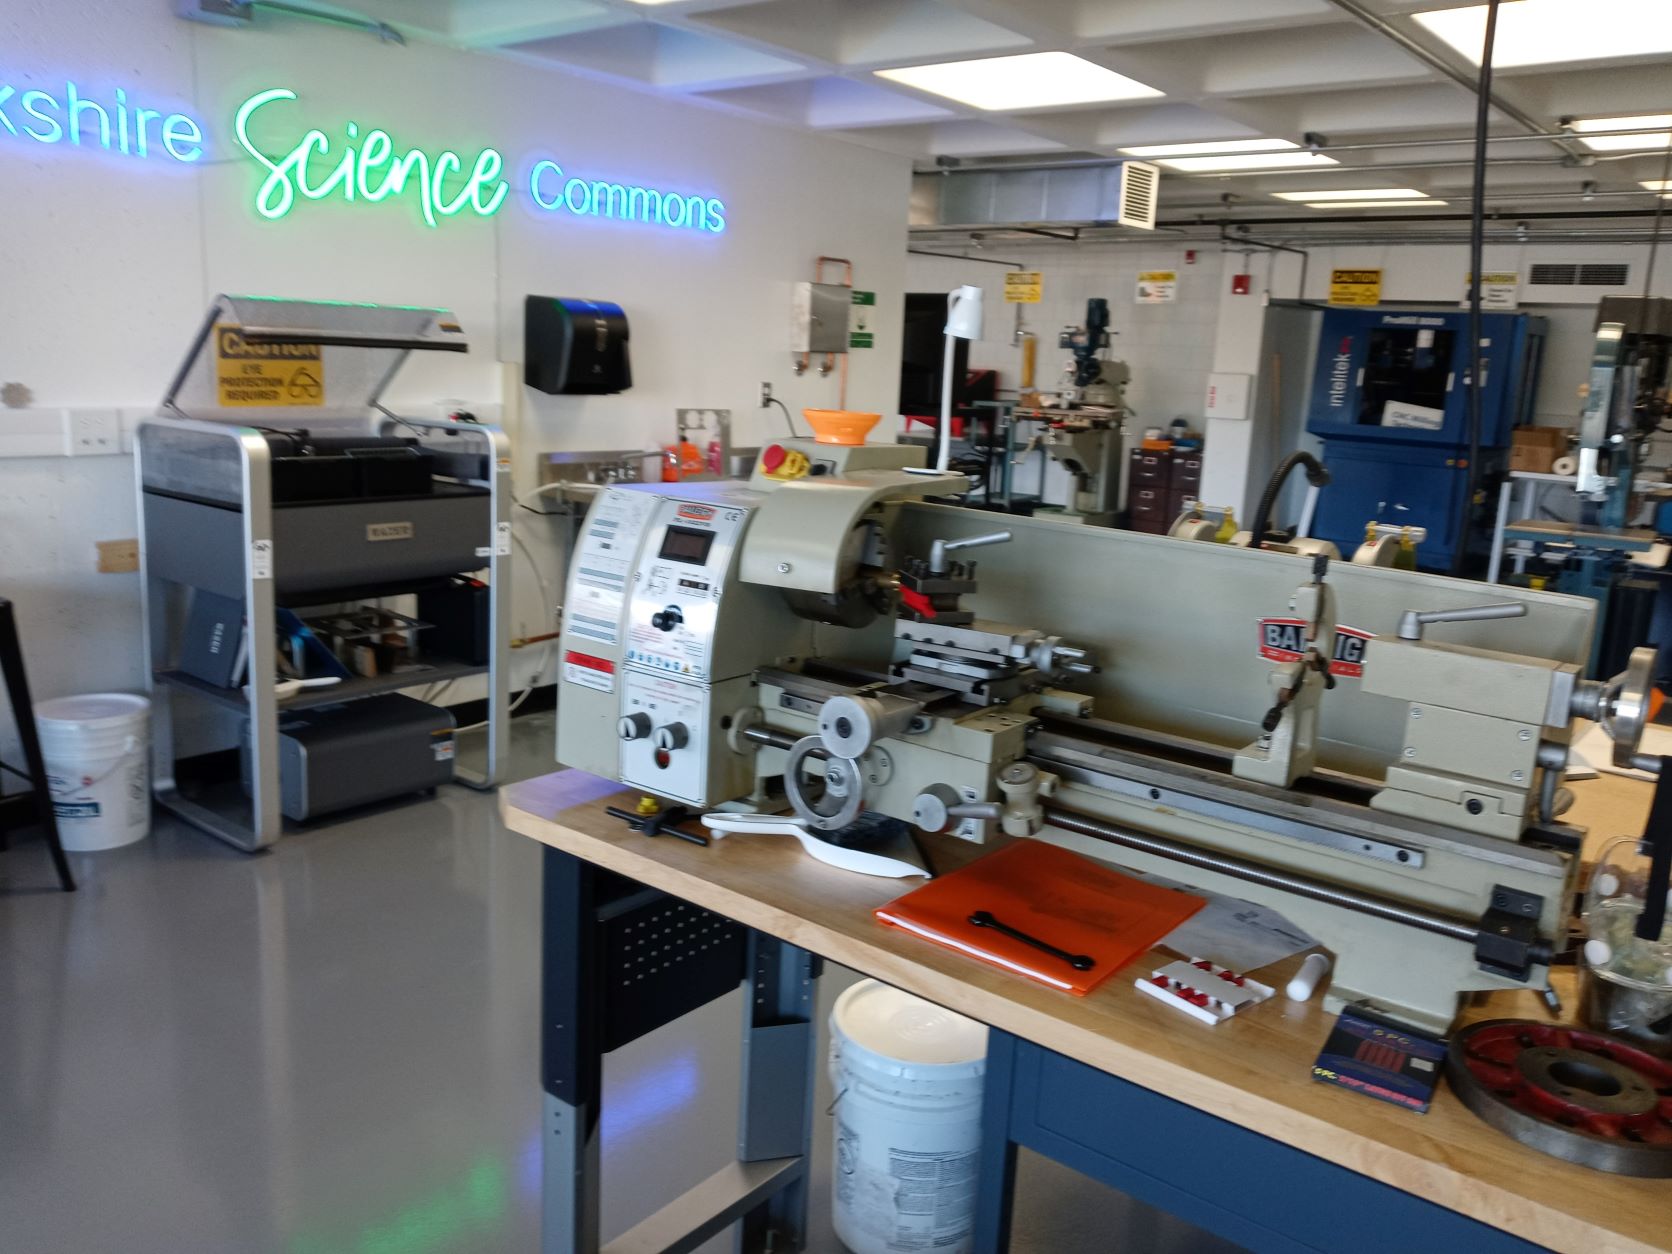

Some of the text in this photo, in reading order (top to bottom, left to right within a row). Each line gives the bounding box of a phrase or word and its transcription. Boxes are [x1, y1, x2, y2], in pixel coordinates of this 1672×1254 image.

[234, 88, 509, 228] Science
[530, 160, 726, 233] Commons
[241, 364, 263, 375] EYE
[220, 377, 284, 388] PROTECTION
[1329, 353, 1352, 406] intelitek
[226, 390, 281, 401] REQUIRED
